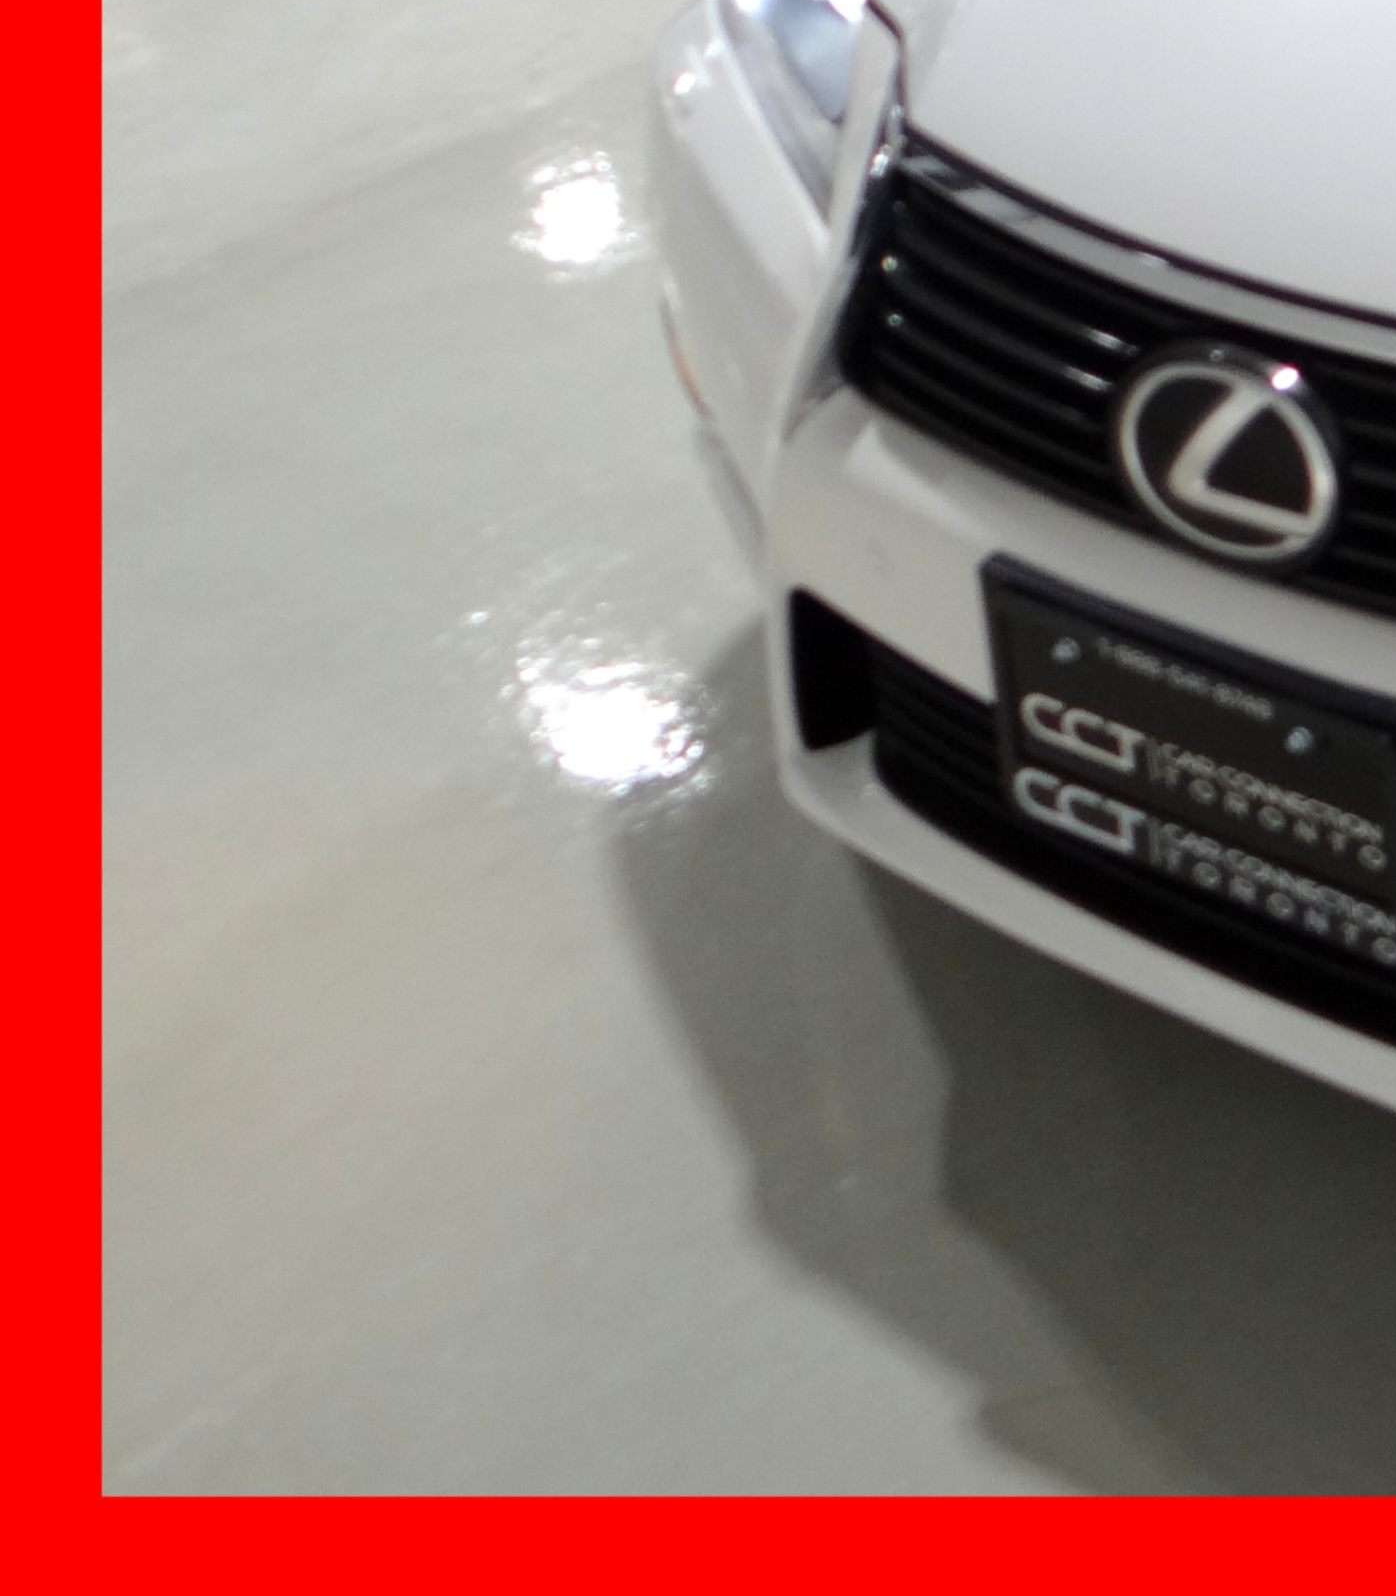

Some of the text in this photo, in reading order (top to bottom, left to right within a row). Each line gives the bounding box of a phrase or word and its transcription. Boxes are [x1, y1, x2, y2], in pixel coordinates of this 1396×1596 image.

[1161, 742, 1216, 778] CAR
[1217, 766, 1384, 844] CONNECTION
[1161, 822, 1223, 860] CAR
[1165, 764, 1388, 871] TORONTO
